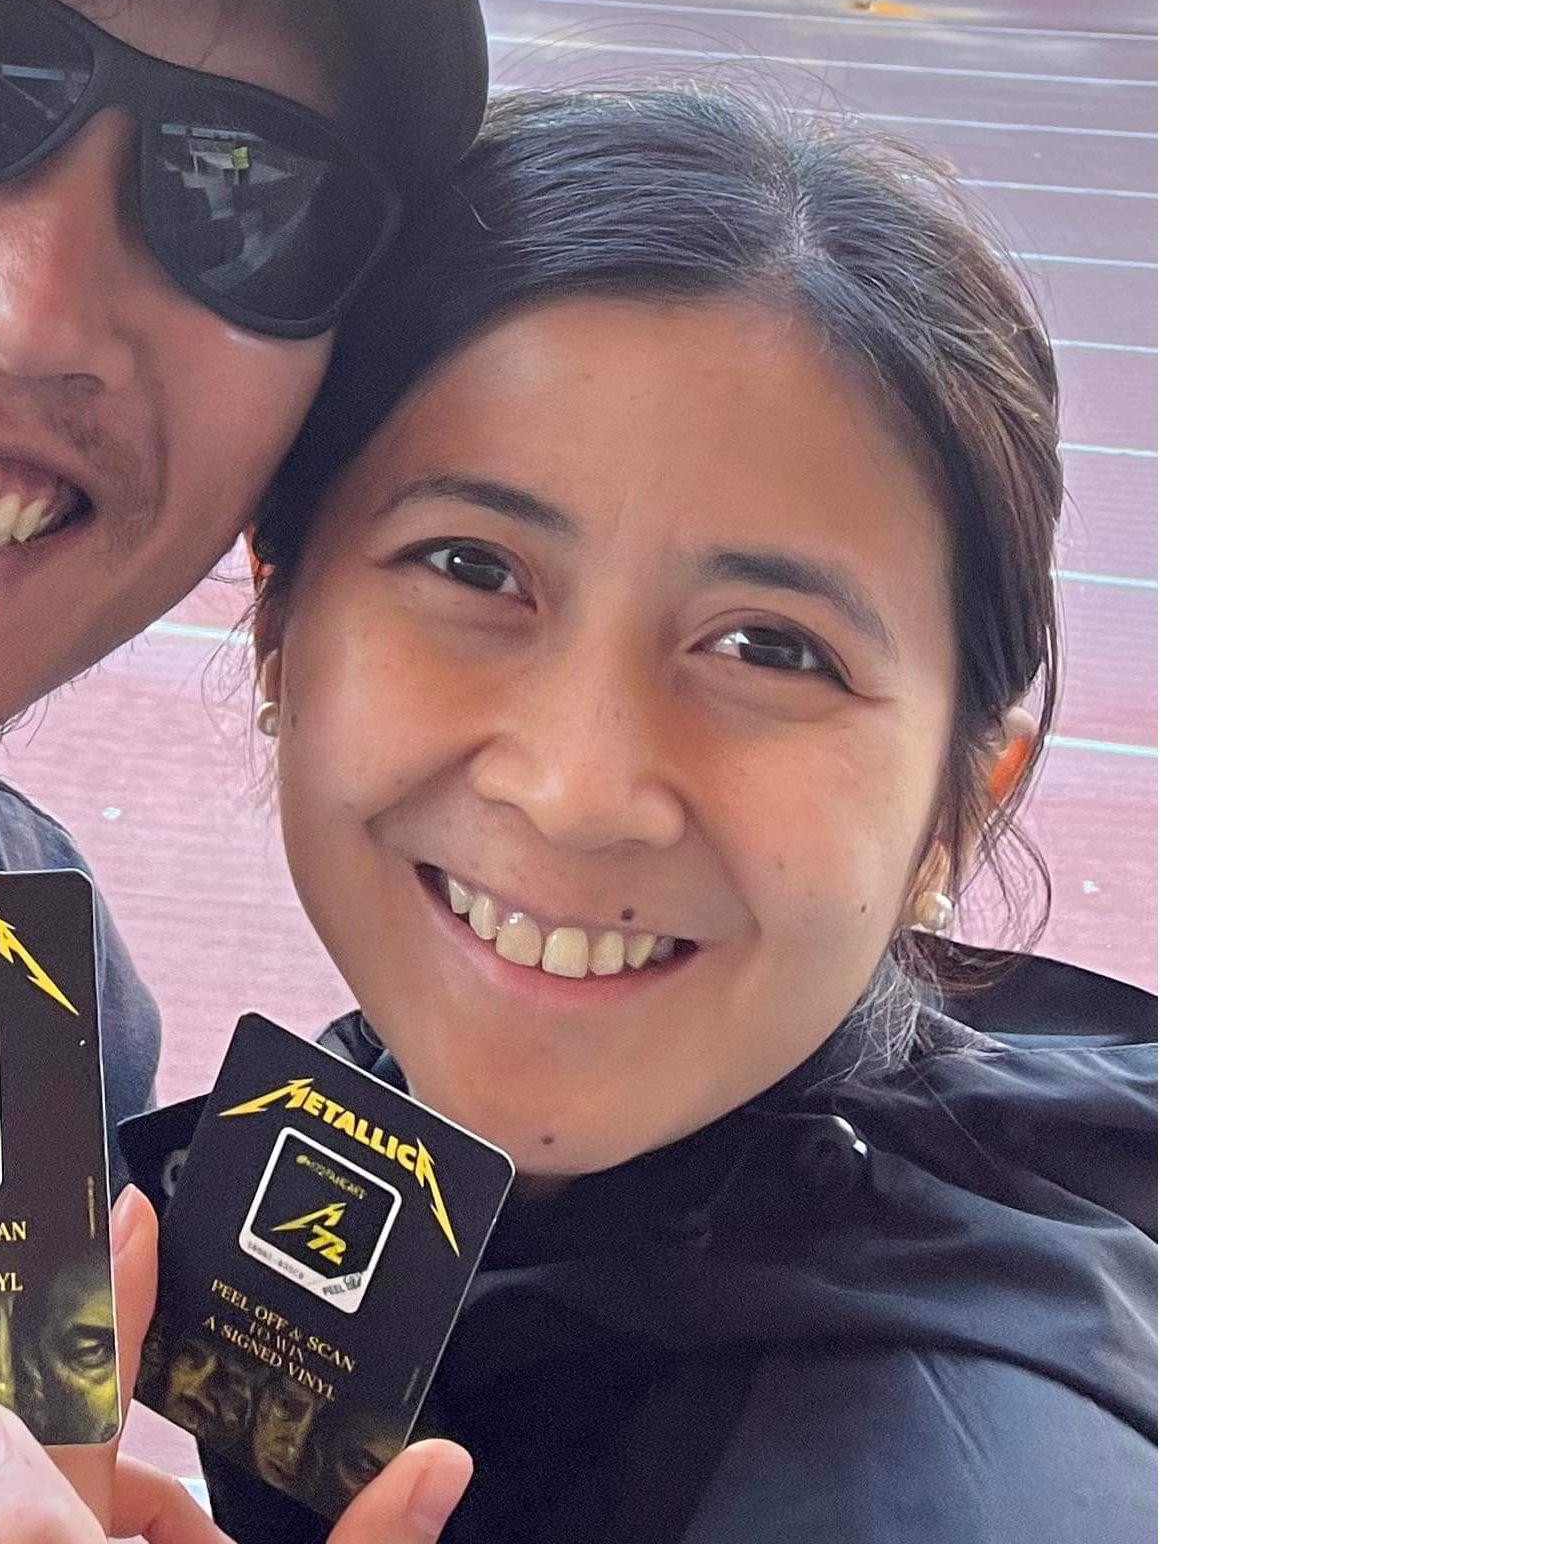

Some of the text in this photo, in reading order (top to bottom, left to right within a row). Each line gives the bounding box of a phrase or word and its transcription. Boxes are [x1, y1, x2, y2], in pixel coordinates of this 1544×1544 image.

[219, 1078, 460, 1257] METALLICA
[204, 1315, 336, 1402] A SIGNED VINYL
[211, 1278, 250, 1312] PEEL
[254, 1306, 289, 1331] OFF
[307, 1336, 355, 1373] SCAN
[249, 1320, 304, 1363] TO WIN
